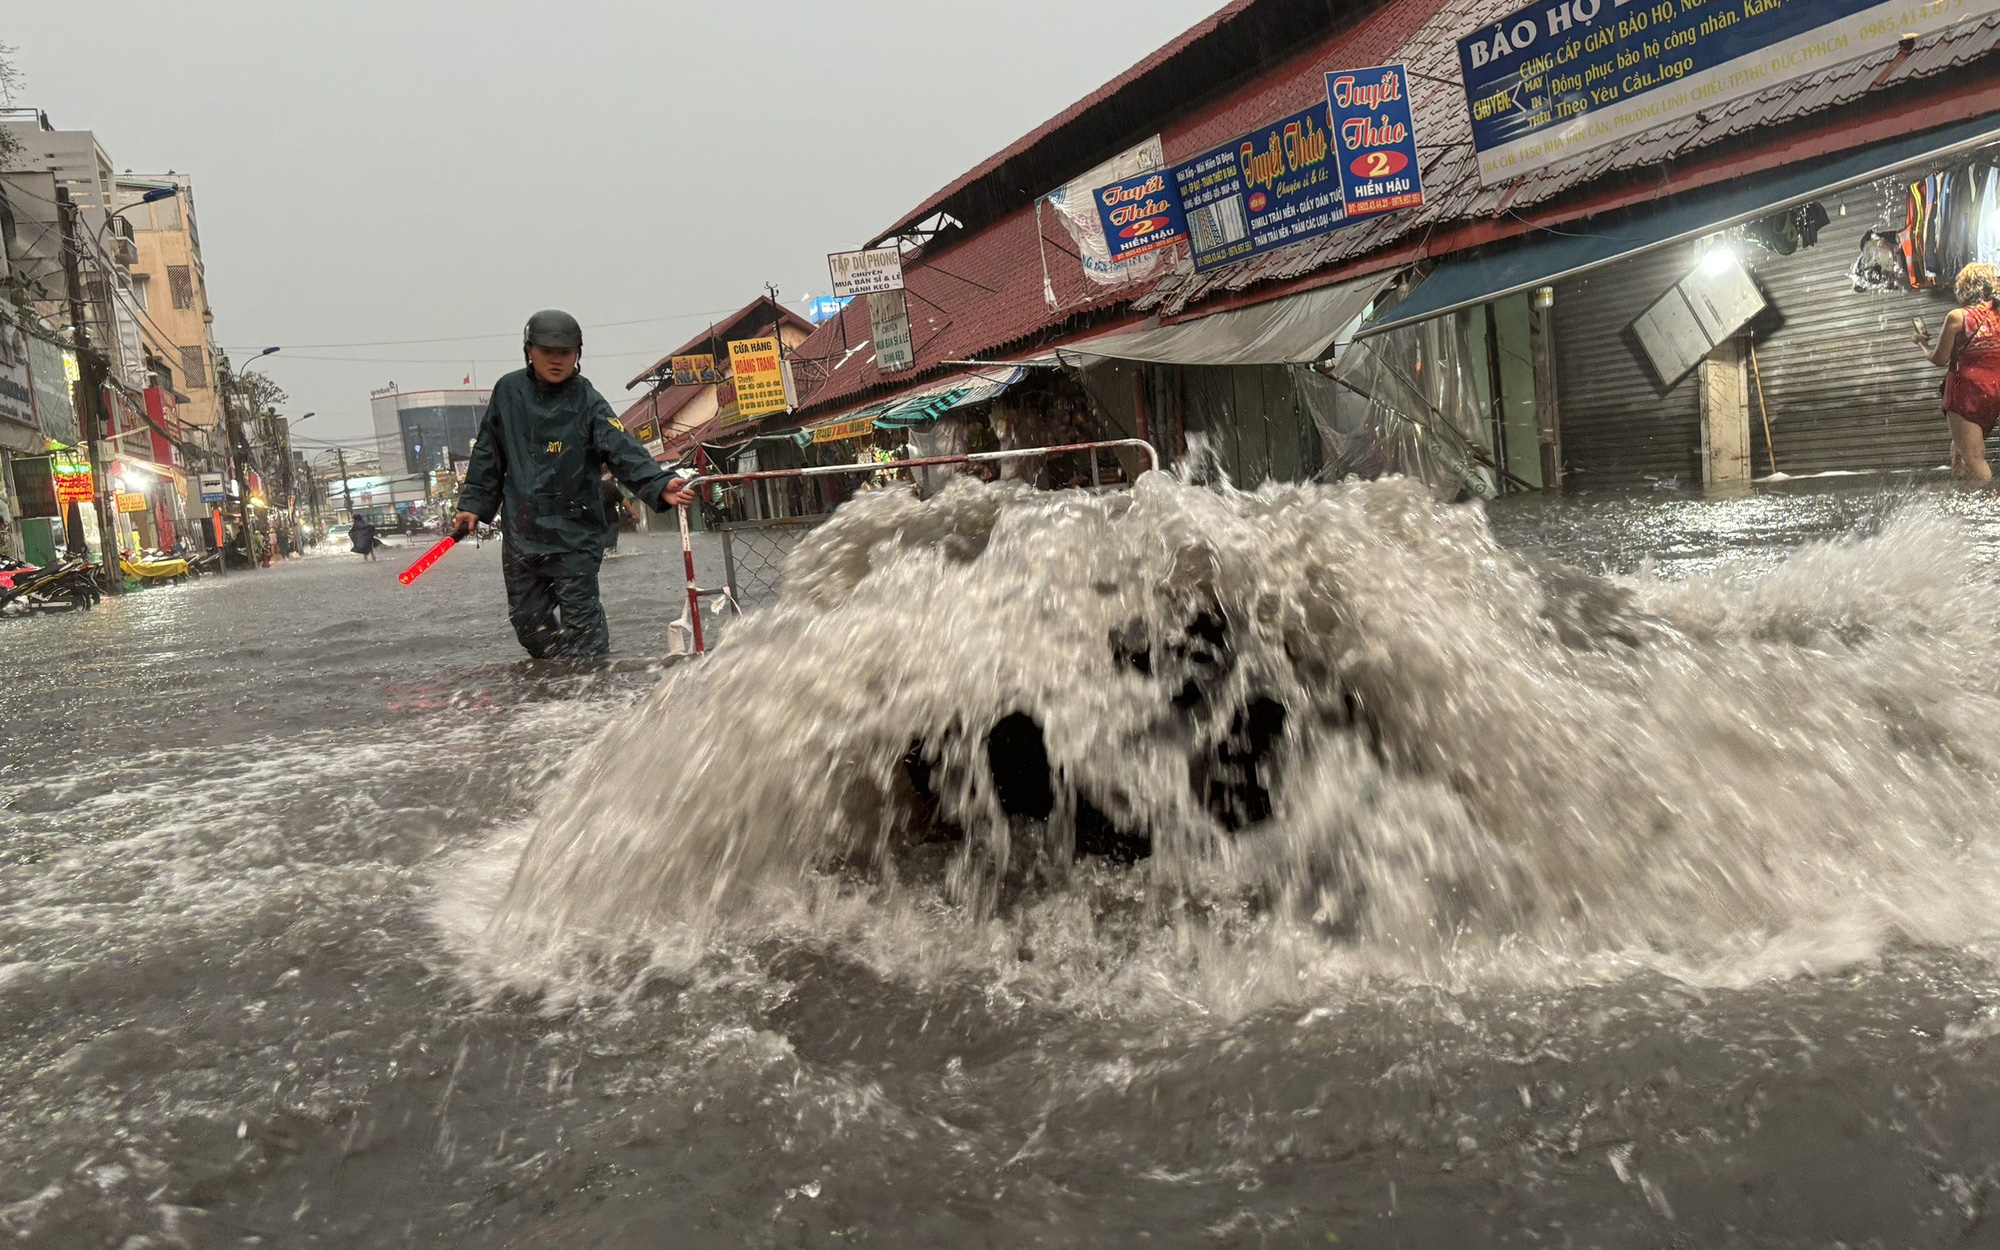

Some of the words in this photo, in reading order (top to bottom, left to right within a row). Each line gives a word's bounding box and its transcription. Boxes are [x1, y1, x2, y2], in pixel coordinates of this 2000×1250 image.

[1469, 19, 1537, 69] BẢO
[1519, 52, 1553, 79] CUNG
[1556, 35, 1582, 65] CẤP
[1584, 25, 1615, 55] GIÀY
[1618, 10, 1648, 40] BẢO
[1551, 73, 1583, 96] Đồng
[1584, 59, 1614, 84] phục
[1616, 47, 1640, 71] bảo
[1643, 39, 1661, 61] hộ
[1663, 28, 1697, 53] công
[1700, 12, 1741, 36] nhân.
[1333, 71, 1402, 110] Tuyết
[1524, 76, 1543, 94] MAY
[1531, 95, 1543, 109] IN
[1554, 98, 1589, 119] Theo
[1590, 85, 1619, 107] Yêu
[1527, 109, 1551, 129] THÊU
[1342, 114, 1408, 150] Thảo
[1240, 131, 1285, 190] Tuyết
[1284, 115, 1327, 171] Thảo
[1518, 147, 1542, 164] 1150
[1543, 140, 1565, 156] KHA
[1367, 152, 1390, 177] 2
[1102, 175, 1165, 206] Tuyết
[1276, 181, 1301, 199] Chuyên
[1386, 178, 1410, 195] HẬU
[1109, 199, 1171, 226] Thảo
[1250, 215, 1269, 230] SIMILI
[1268, 207, 1284, 224] TRẢI
[1299, 196, 1315, 213] GIẤY
[1305, 215, 1317, 231] CÁC
[1316, 212, 1329, 228] LOẠI
[1132, 220, 1155, 236] 2
[1151, 228, 1175, 241] HẬU
[867, 251, 899, 268] PHONG
[835, 280, 853, 288] MUA
[854, 277, 871, 286] BÁN
[851, 269, 883, 278] CHUYÊN
[849, 285, 871, 294] BÁNH
[873, 283, 890, 292] KẸO
[733, 341, 750, 354] CỬA
[750, 340, 772, 352] HÀNG
[734, 356, 757, 374] HOÀNG
[756, 355, 776, 372] TRANG
[547, 441, 563, 454] QTV
